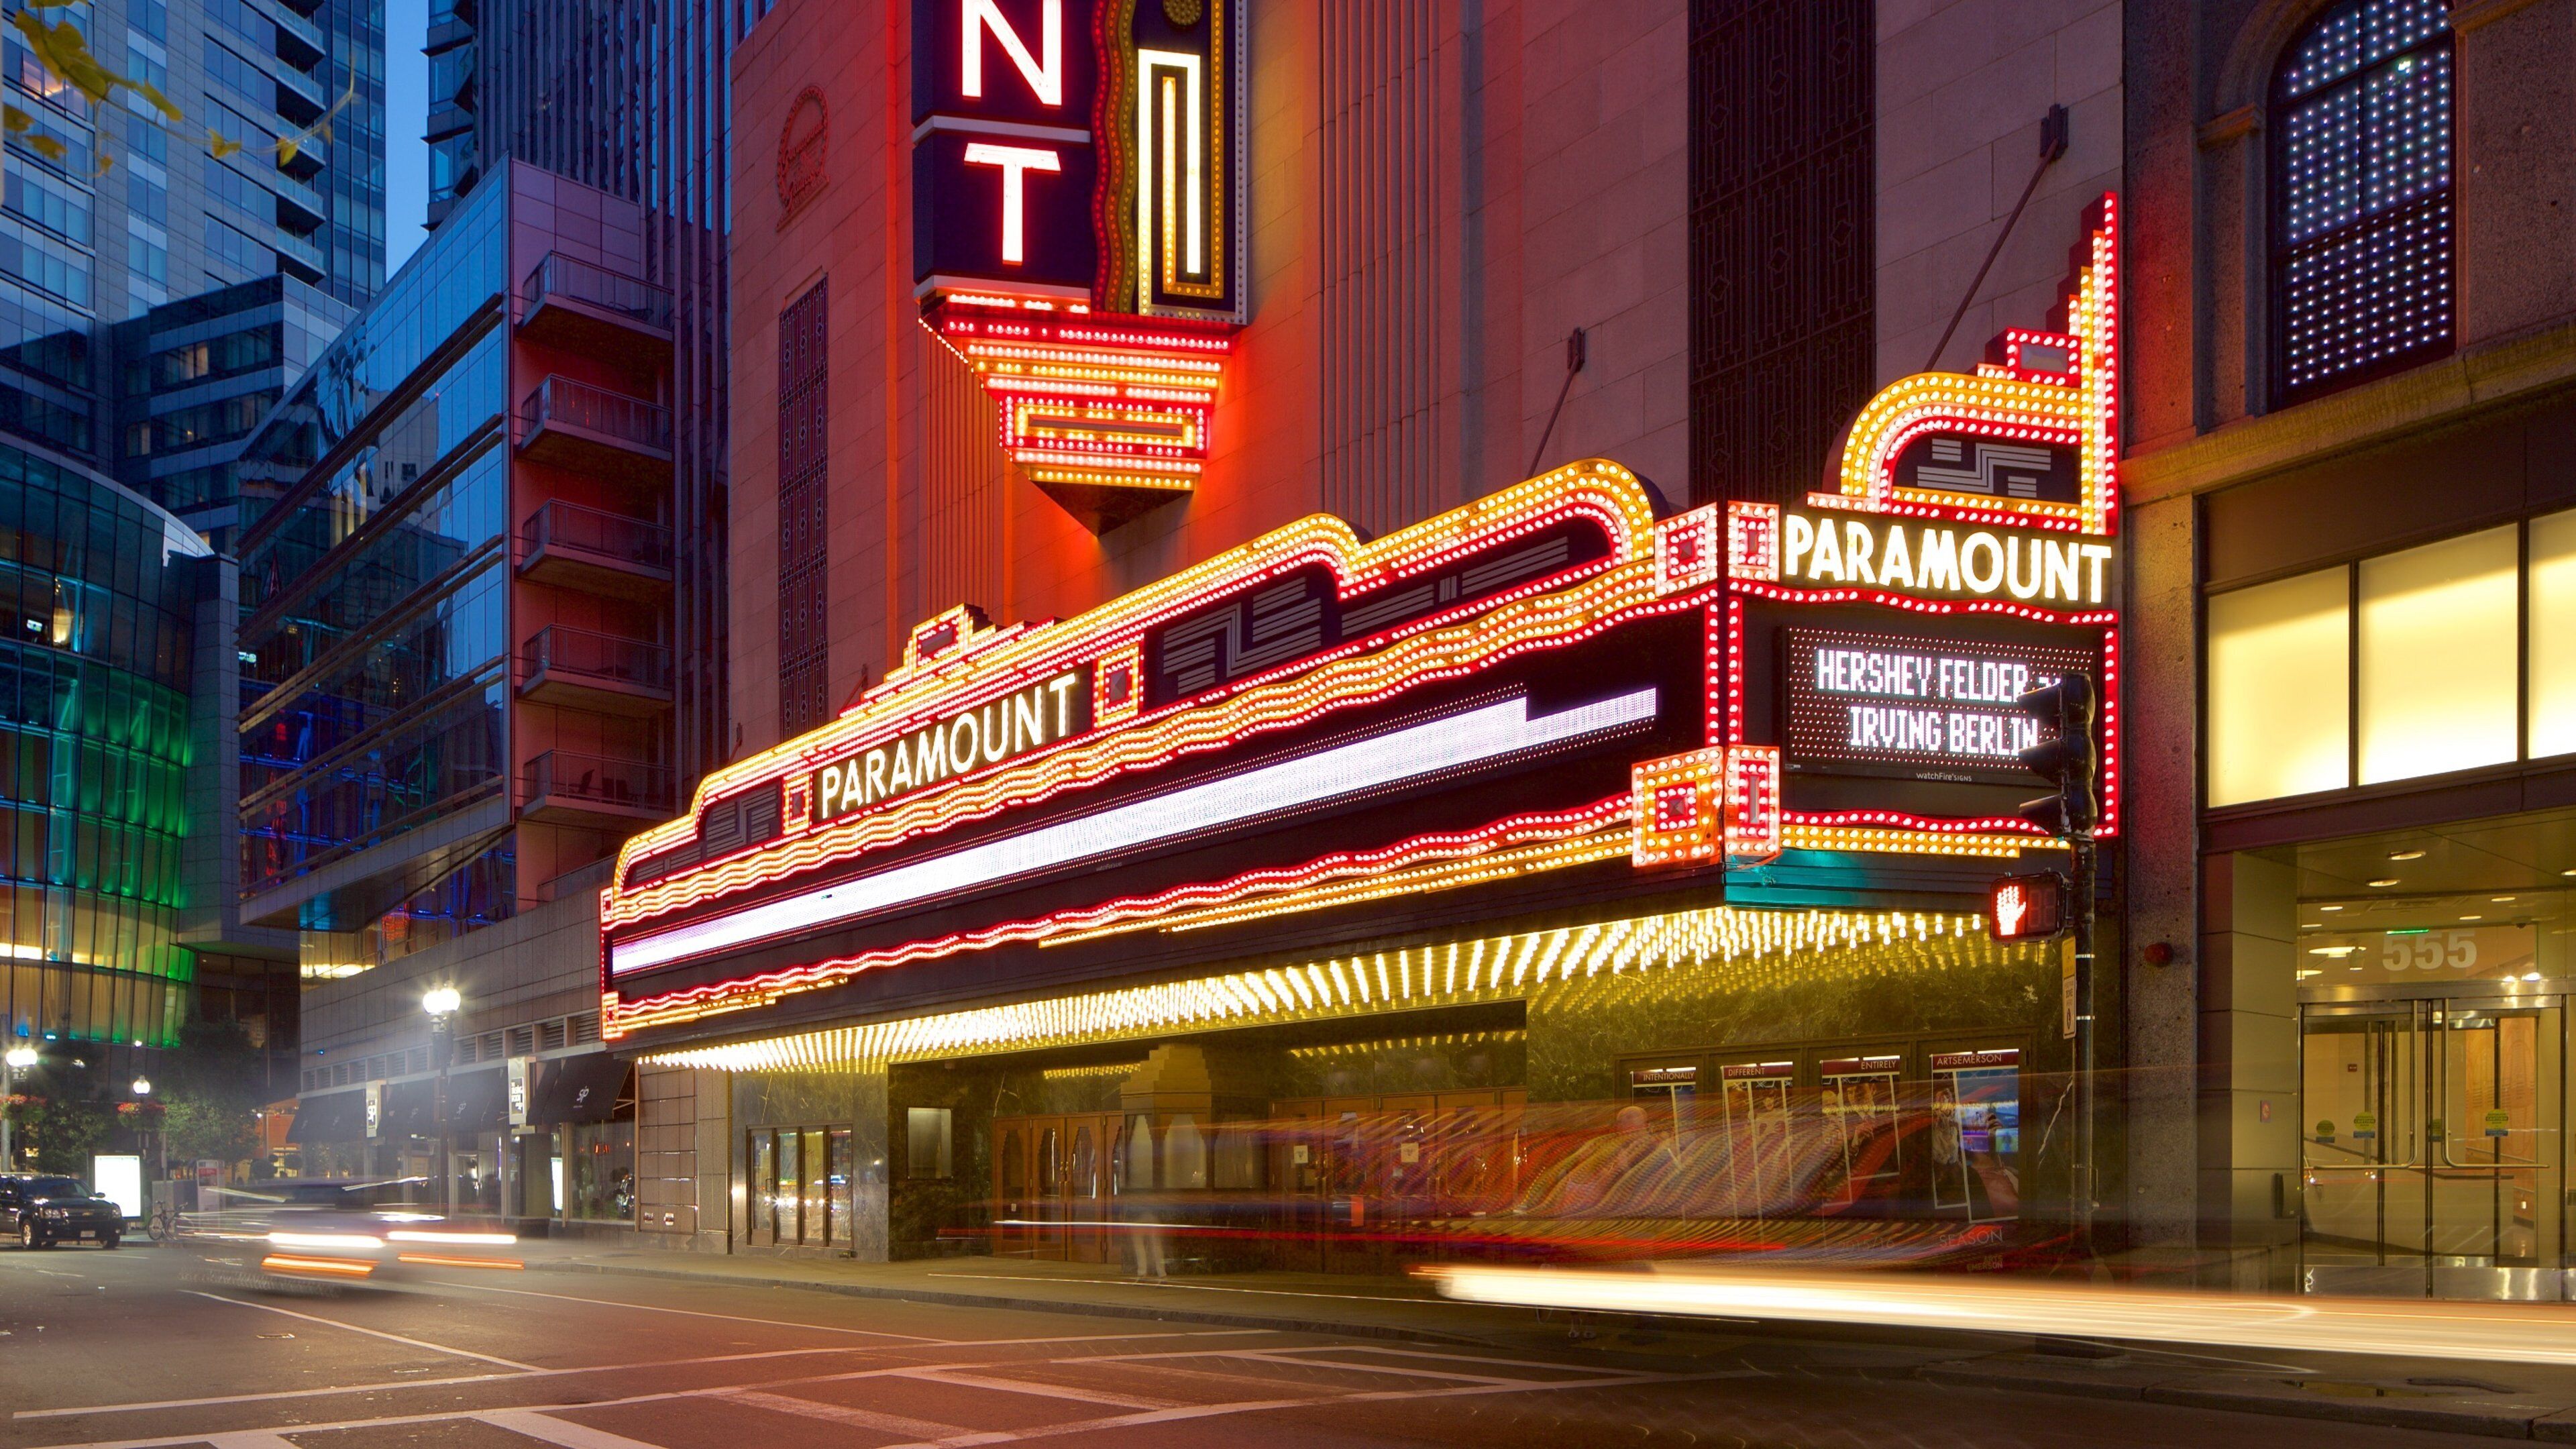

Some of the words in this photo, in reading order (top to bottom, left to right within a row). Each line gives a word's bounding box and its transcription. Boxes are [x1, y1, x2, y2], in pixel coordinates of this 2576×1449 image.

[1786, 515, 2112, 603] PARAMOUNT
[1816, 649, 1932, 696] HERSHEY
[1940, 658, 2029, 702] FELDER
[822, 673, 1077, 819] PARAMOUNT
[1850, 706, 1941, 751] IRVING
[1949, 712, 2038, 757] BERLIN
[2382, 930, 2477, 971] 555
[1728, 1067, 1766, 1077] DIFFERENT
[1861, 1060, 1896, 1070] ENTIRELY
[1937, 1054, 2002, 1065] ARTSEMERSON
[1643, 1072, 1695, 1081] INTENTIONALLY
[1939, 1228, 2003, 1247] SEASON
